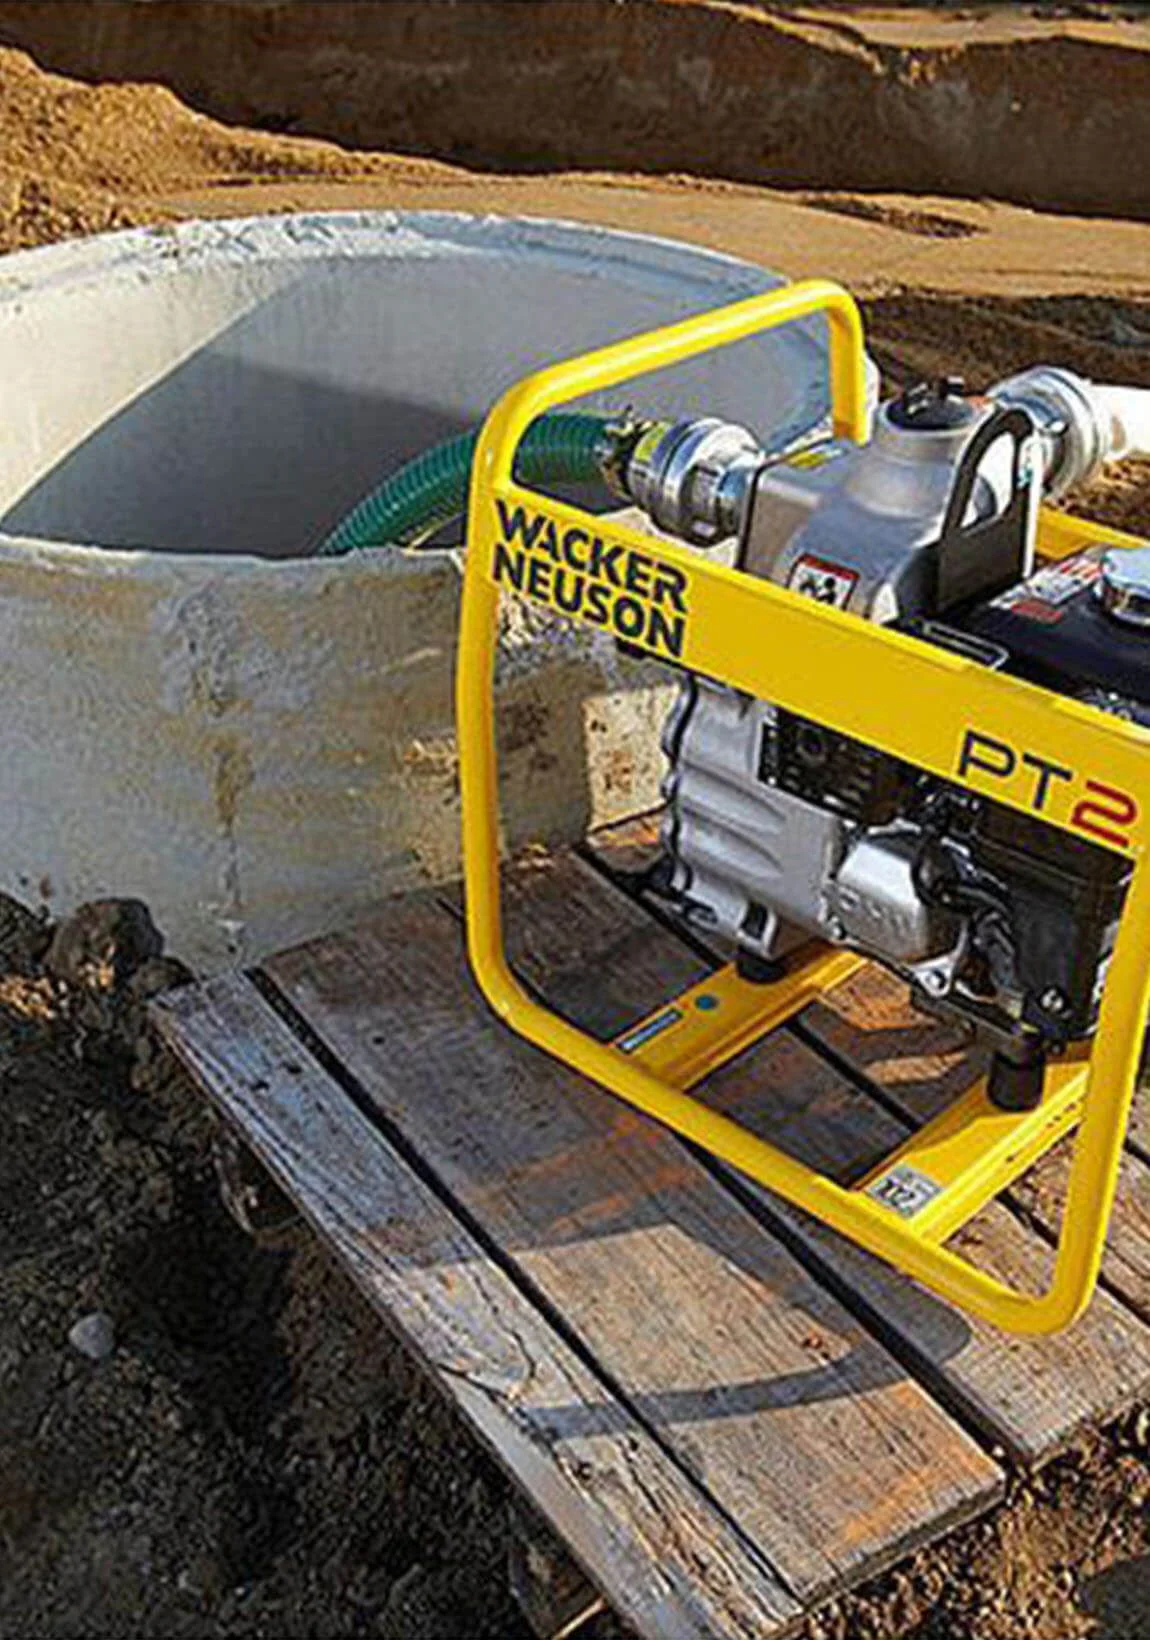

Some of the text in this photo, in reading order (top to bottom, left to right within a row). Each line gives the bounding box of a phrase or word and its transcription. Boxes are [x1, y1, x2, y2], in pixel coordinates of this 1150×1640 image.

[494, 543, 684, 657] NEUSON
[496, 499, 687, 613] WACKER
[958, 730, 1136, 848] PT2
